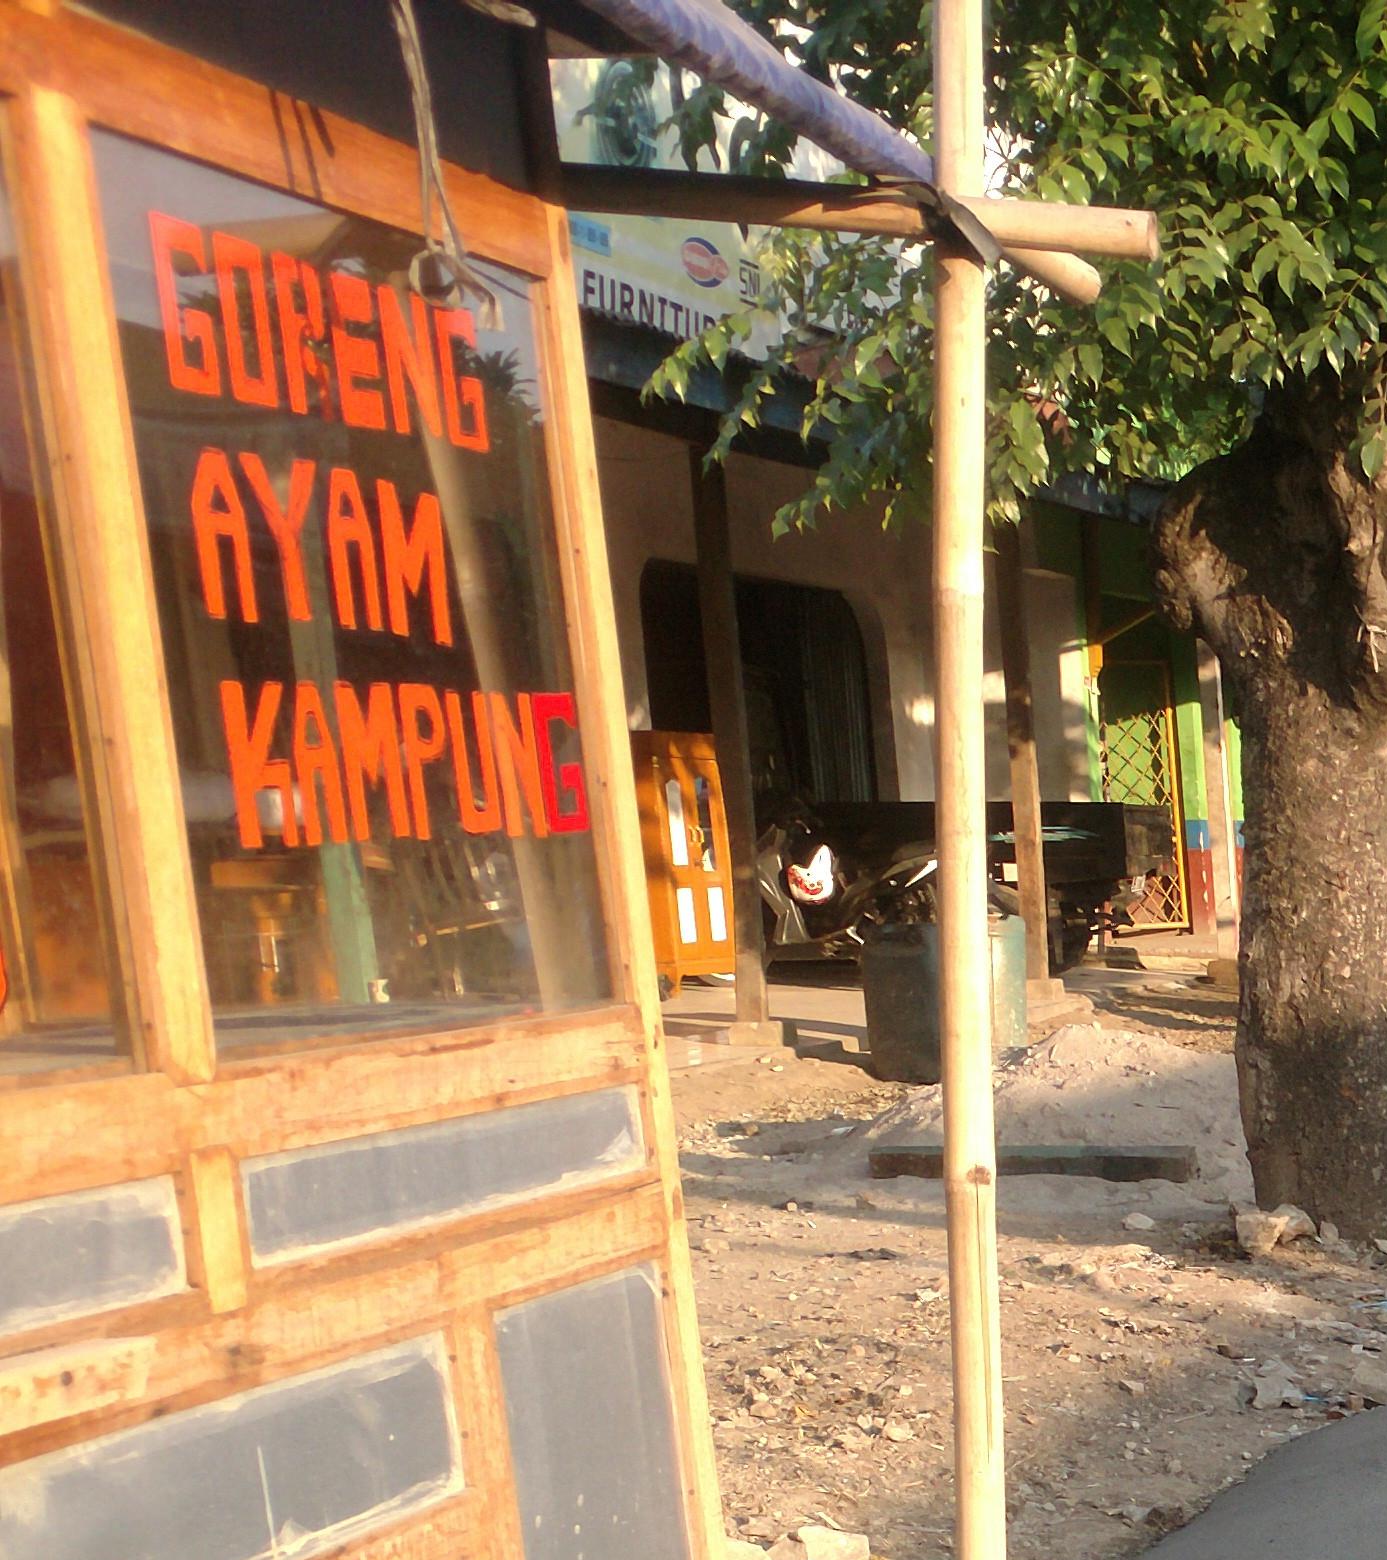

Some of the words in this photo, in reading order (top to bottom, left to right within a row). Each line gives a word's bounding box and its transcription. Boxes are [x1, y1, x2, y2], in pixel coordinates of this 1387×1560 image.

[147, 209, 490, 453] GORENG
[582, 268, 717, 341] FURNITUR
[738, 267, 761, 297] SNI
[191, 446, 453, 647] AYAM
[219, 680, 590, 849] KAMPUNG
